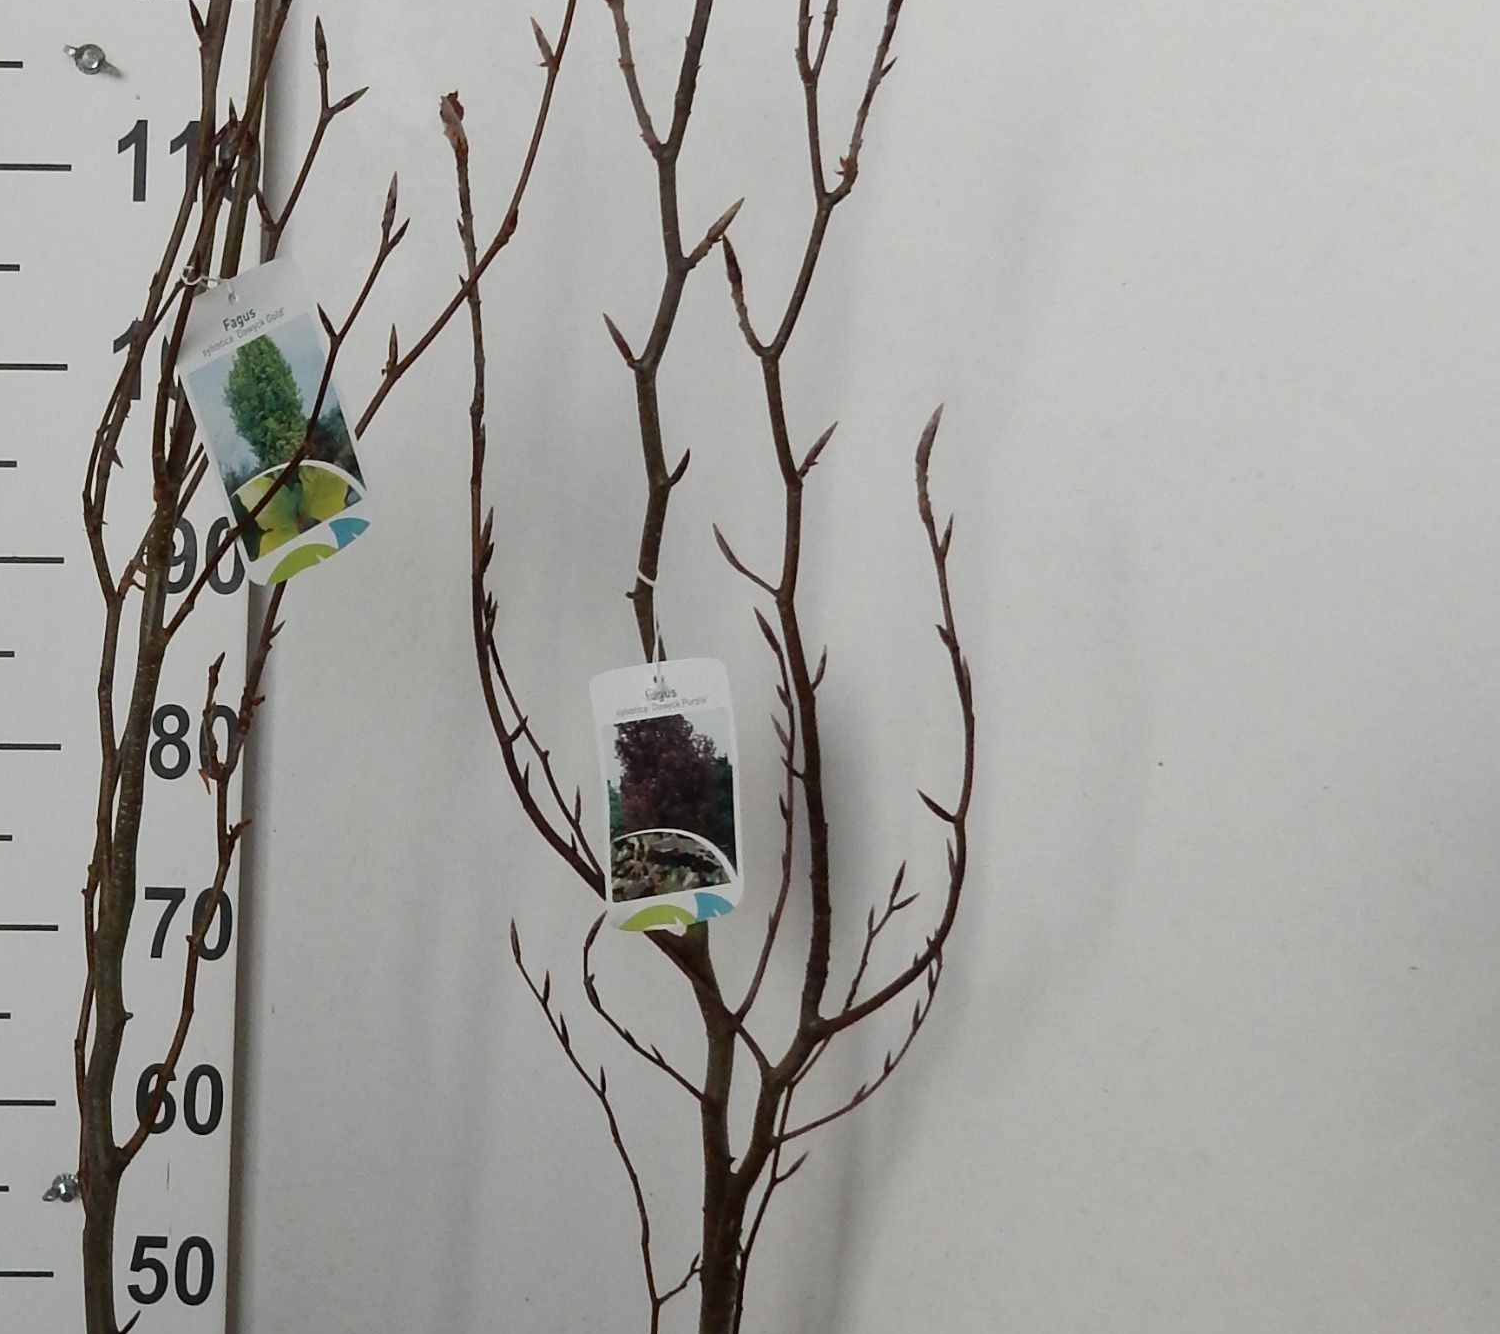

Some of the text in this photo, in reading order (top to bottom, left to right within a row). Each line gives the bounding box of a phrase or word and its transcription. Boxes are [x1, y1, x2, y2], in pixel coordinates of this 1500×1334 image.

[223, 308, 257, 331] Fagus
[163, 516, 246, 595] 90
[149, 703, 240, 780] 80
[145, 886, 234, 960] 70
[136, 1063, 224, 1137] 60
[127, 1235, 215, 1307] 50
